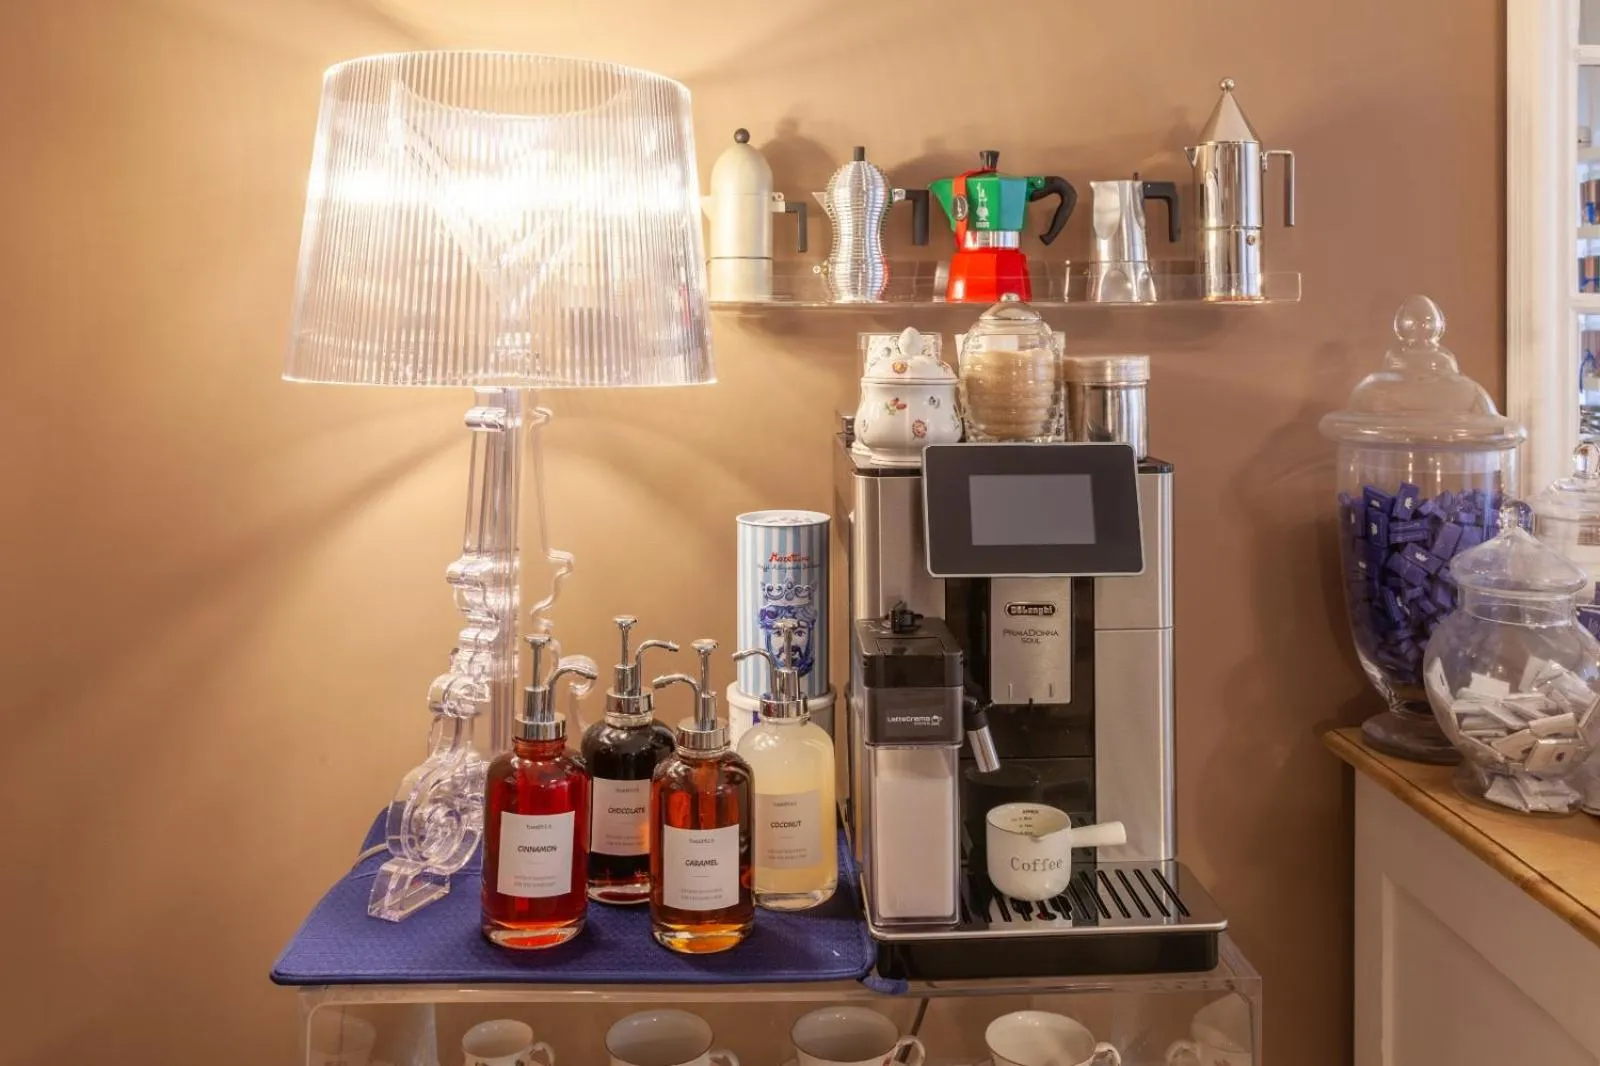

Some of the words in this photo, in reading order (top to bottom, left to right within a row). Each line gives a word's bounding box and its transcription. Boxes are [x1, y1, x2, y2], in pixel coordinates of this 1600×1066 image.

[608, 807, 645, 815] CHOCOLATE
[770, 820, 802, 828] COCONUT
[517, 845, 558, 853] CINNAMON
[685, 859, 718, 867] CARAMEL
[1010, 856, 1063, 872] Coffee
